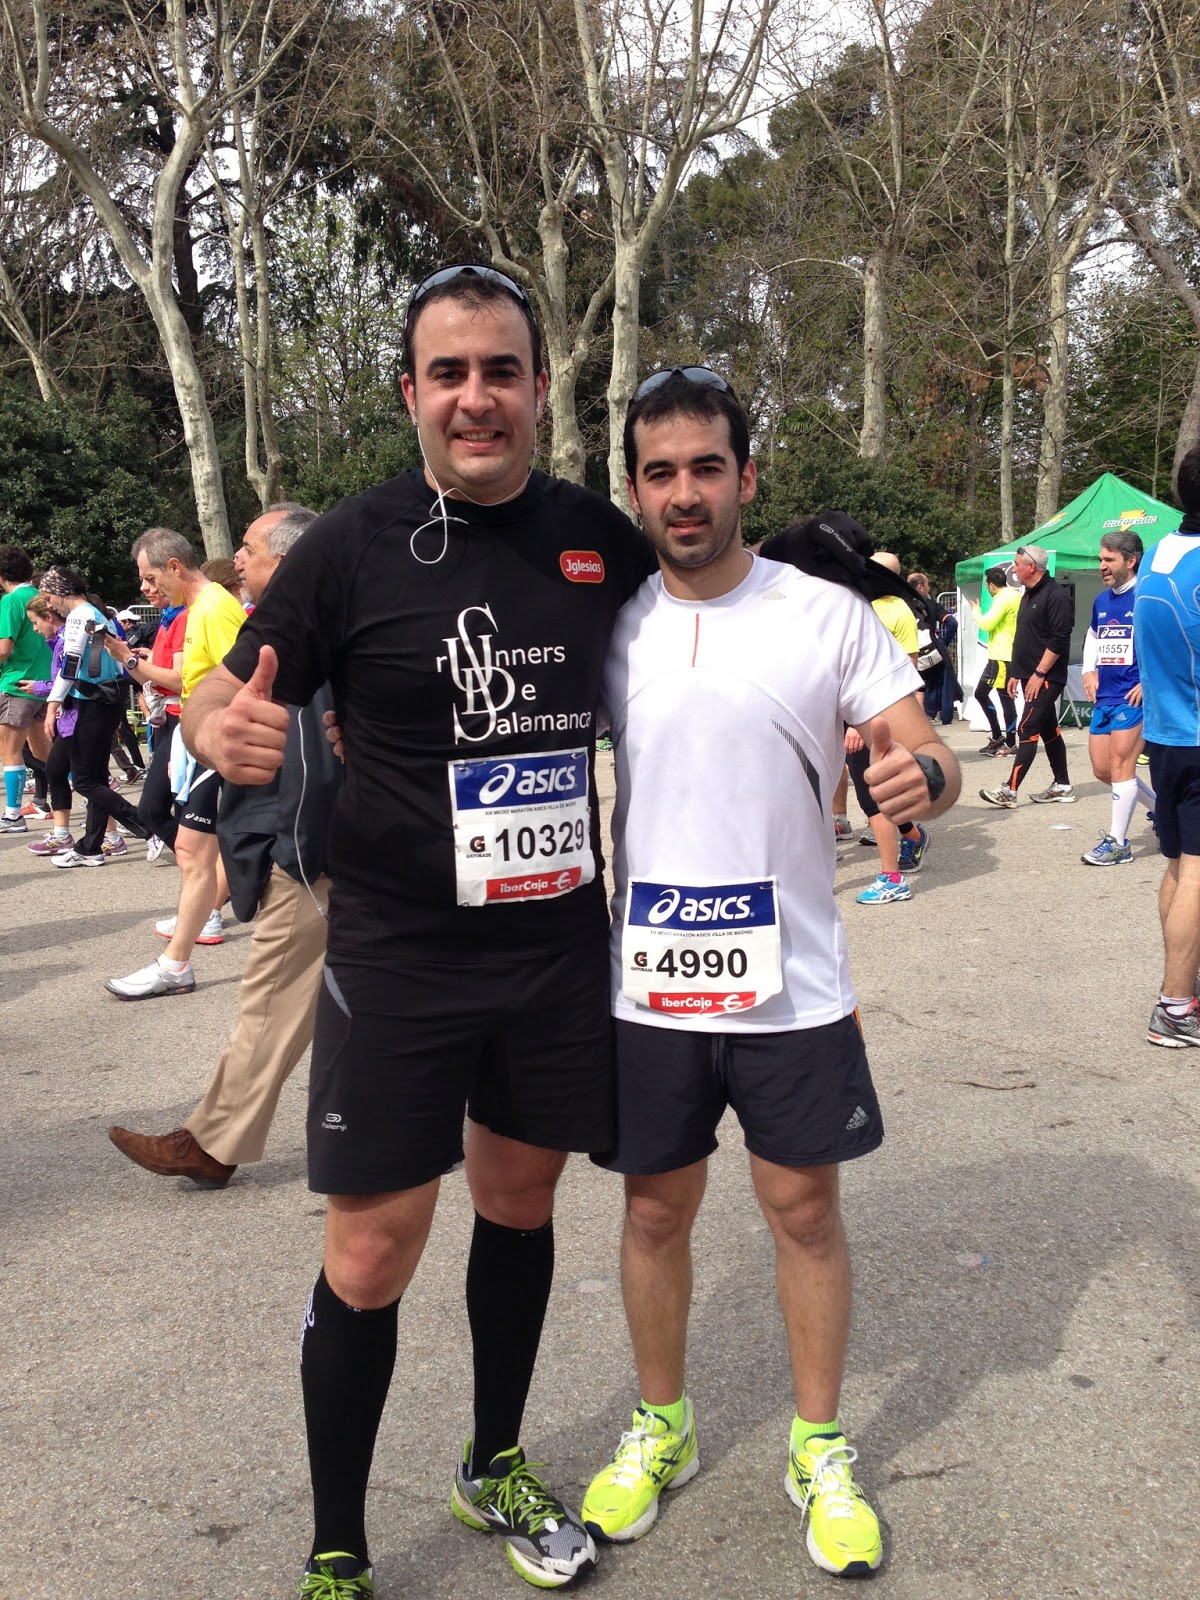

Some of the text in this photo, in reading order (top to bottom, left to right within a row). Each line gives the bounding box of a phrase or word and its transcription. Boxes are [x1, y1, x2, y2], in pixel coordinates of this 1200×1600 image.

[516, 765, 576, 796] asics
[495, 818, 584, 861] 10329
[679, 895, 751, 922] asics
[656, 948, 747, 978] 4990
